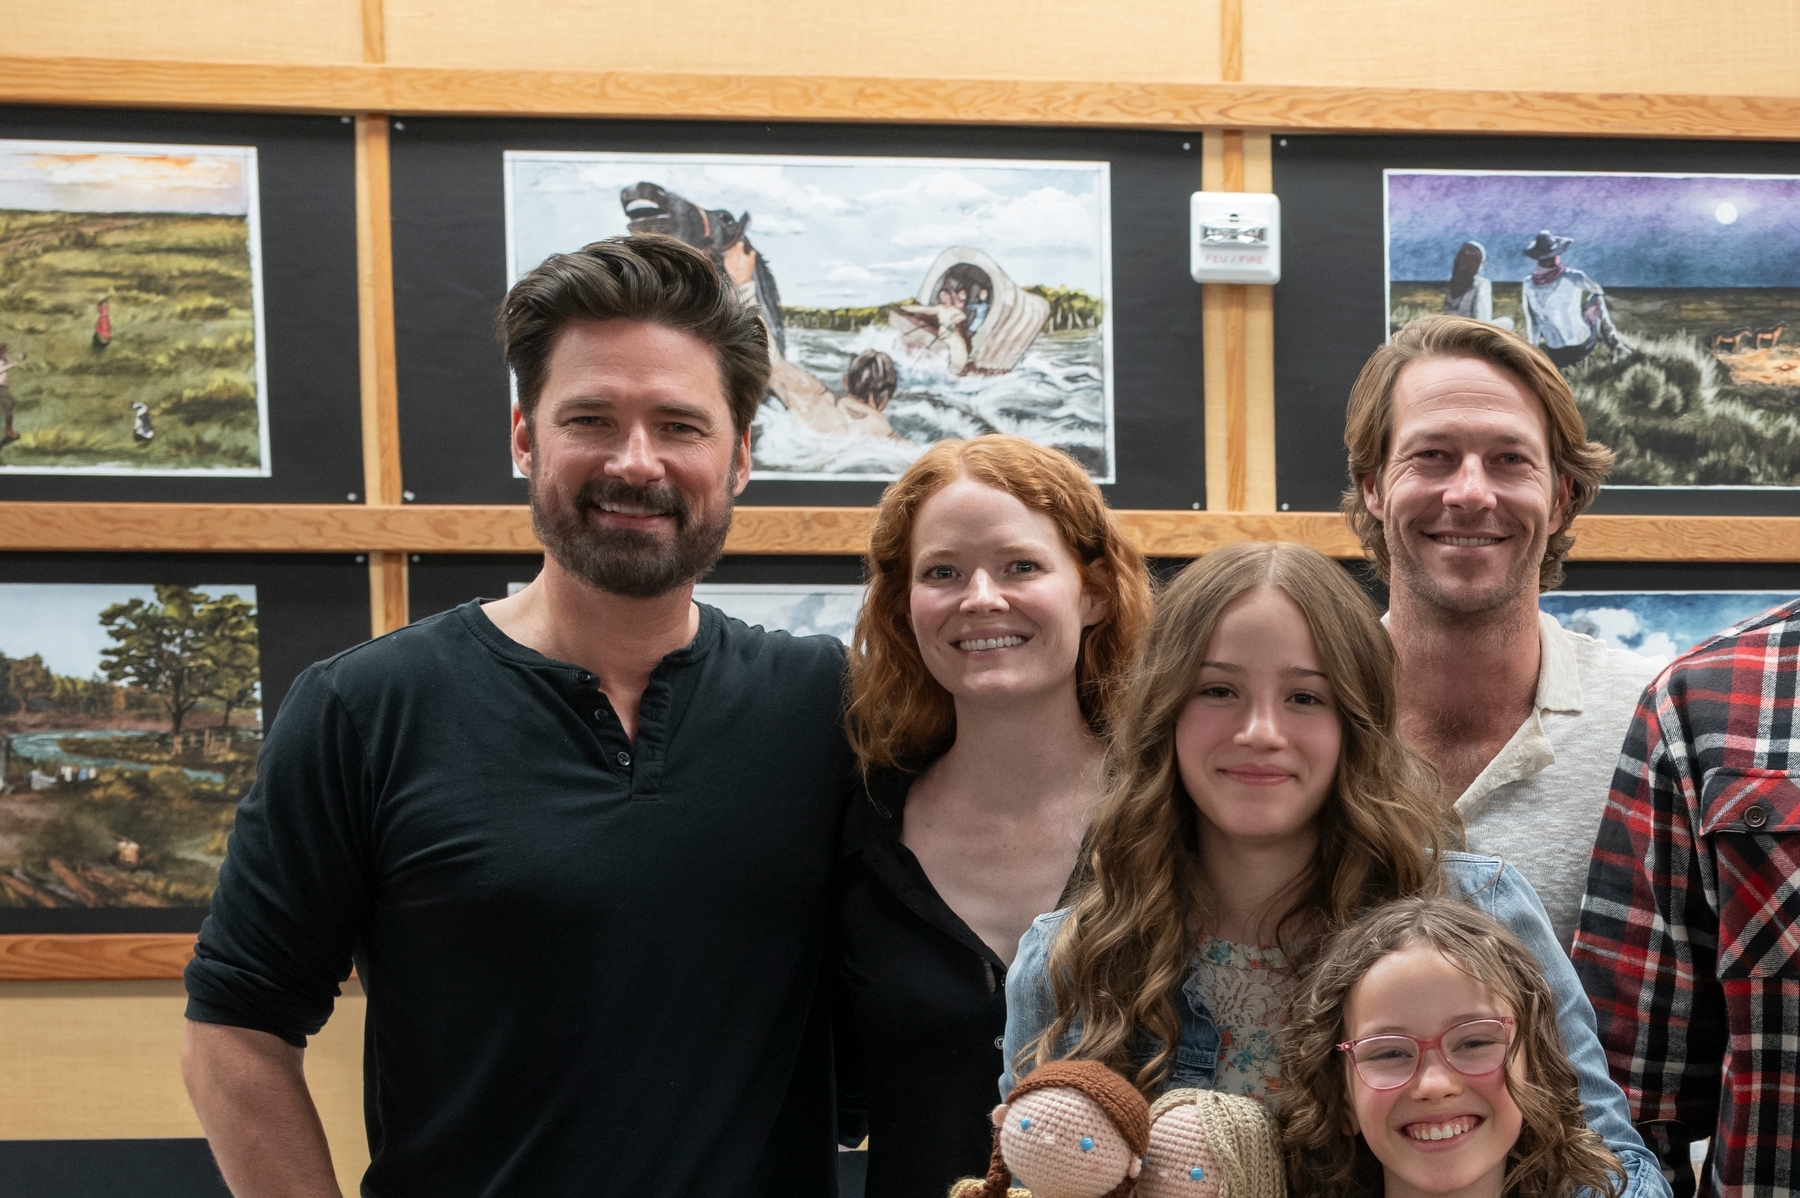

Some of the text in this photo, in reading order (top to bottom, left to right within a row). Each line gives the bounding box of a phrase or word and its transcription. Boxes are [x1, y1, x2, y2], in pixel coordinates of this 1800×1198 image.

[1205, 254, 1263, 264] FEU / FIRE
